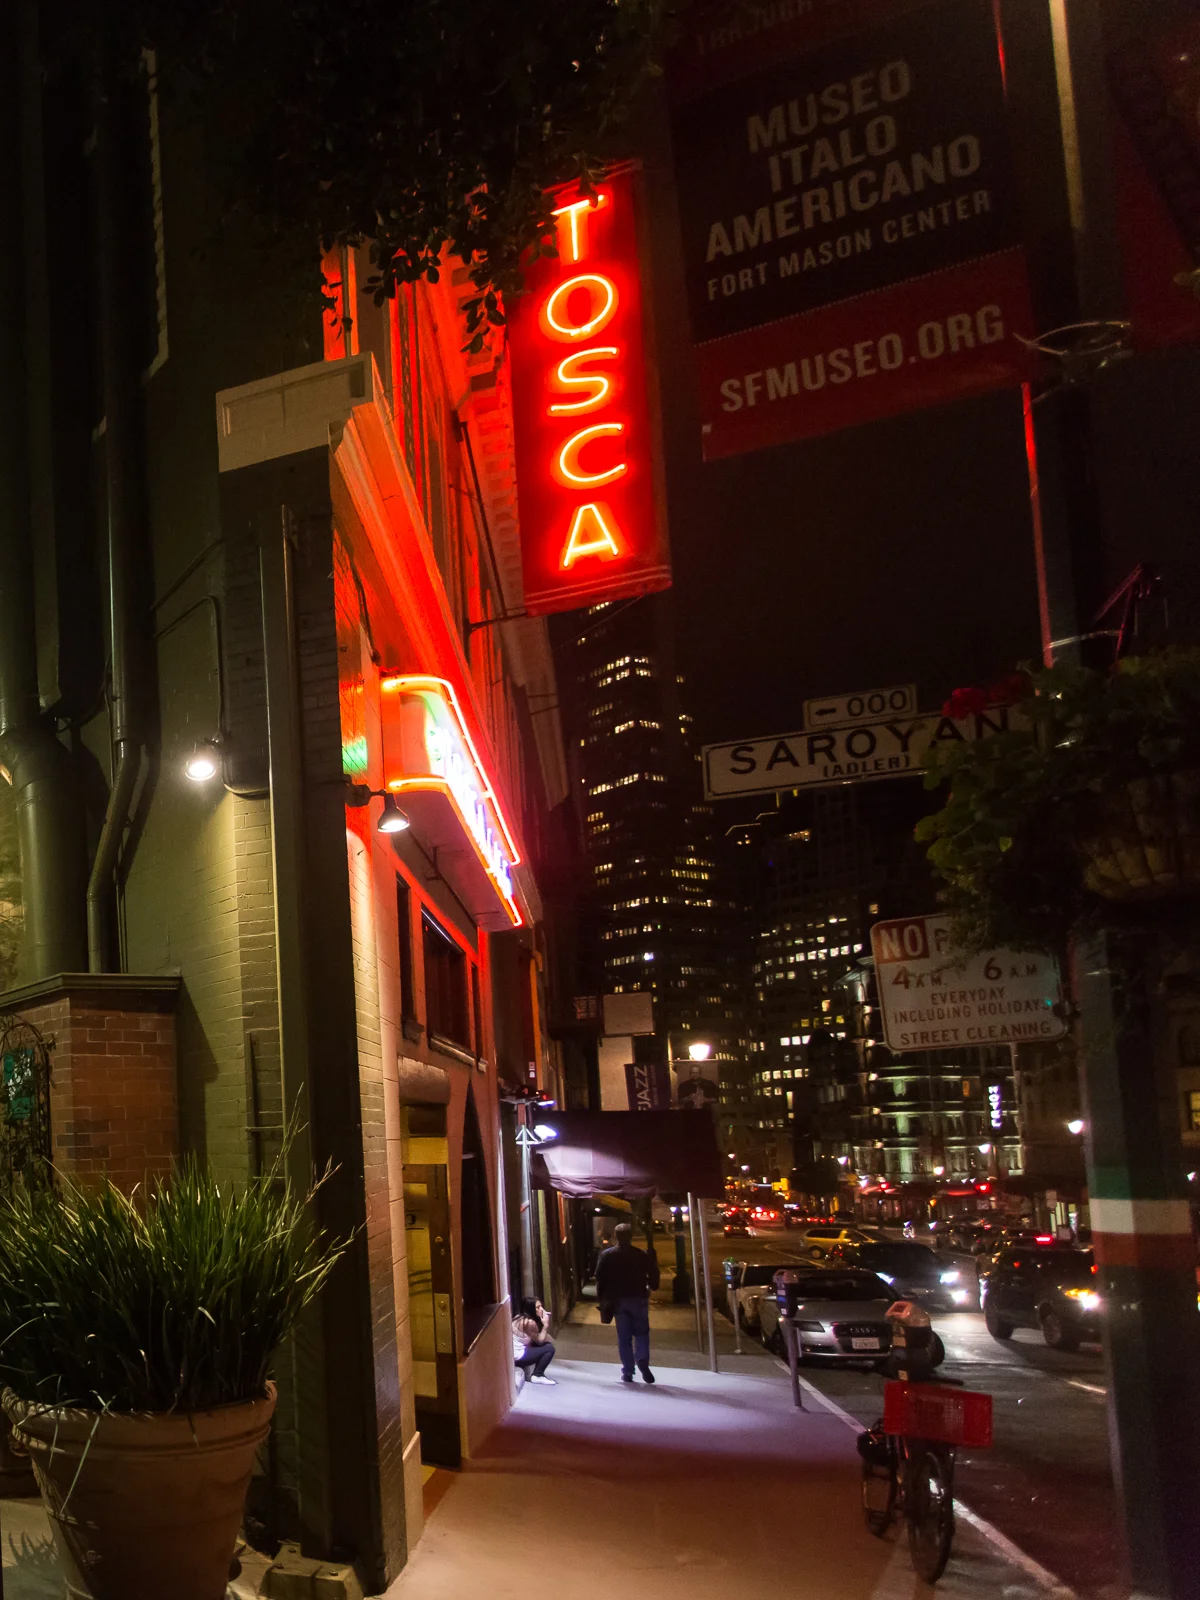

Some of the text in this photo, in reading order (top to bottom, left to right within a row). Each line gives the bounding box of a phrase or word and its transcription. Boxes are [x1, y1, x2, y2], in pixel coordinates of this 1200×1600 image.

[748, 61, 911, 153] MUSEO
[768, 115, 897, 193] ITALO
[705, 134, 981, 262] AMERICANO
[708, 190, 992, 301] FORT MASON CENTER
[546, 193, 627, 568] TOSCA
[719, 304, 1005, 413] SFMUSEO.ORG
[729, 708, 1009, 776] SAROYAN
[823, 755, 911, 779] (ADLER)
[879, 923, 925, 960] NO
[892, 965, 909, 989] 4
[984, 957, 1002, 980] 6
[893, 998, 1052, 1024] INCLUDING HOLIDAYS
[931, 986, 1005, 1006] EVERYDAY
[900, 1020, 1052, 1046] STREET CLEANING
